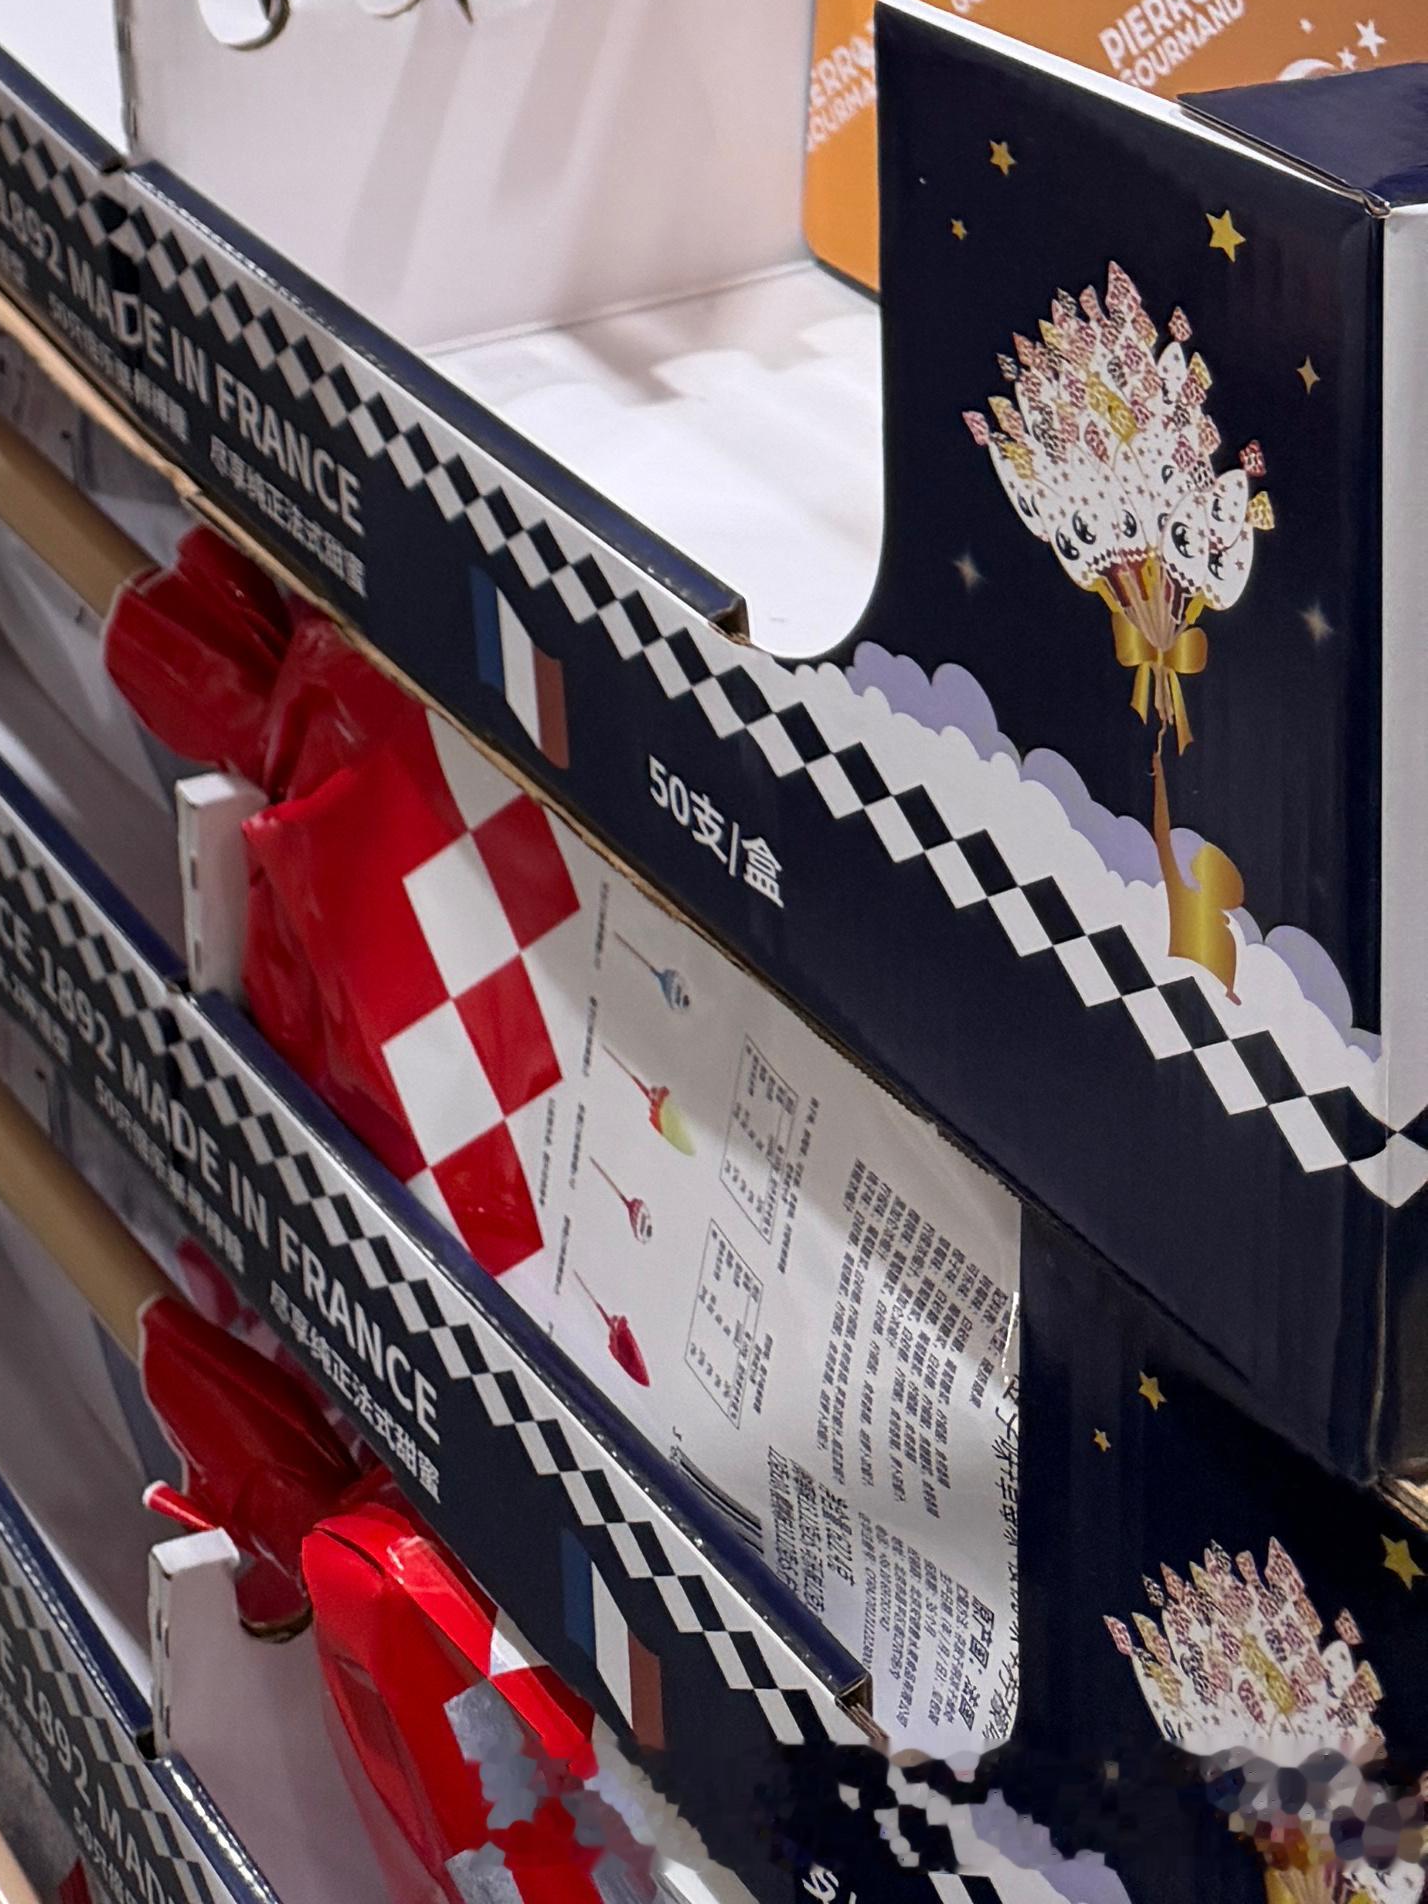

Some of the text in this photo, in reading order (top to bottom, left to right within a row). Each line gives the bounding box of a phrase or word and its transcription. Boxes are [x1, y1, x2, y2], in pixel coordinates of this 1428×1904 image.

[66, 245, 168, 370] MADE
[170, 323, 210, 407] IN
[214, 362, 366, 538] FRANCE
[37, 945, 118, 1073] 1892
[119, 1041, 223, 1195] MADE
[230, 1163, 271, 1251] IN
[277, 1216, 442, 1446] FRANCE
[270, 1279, 442, 1505] 尽享纯正法式甜蜜
[20, 1663, 93, 1807] 1892
[957, 1595, 995, 1731] 原产国：法国
